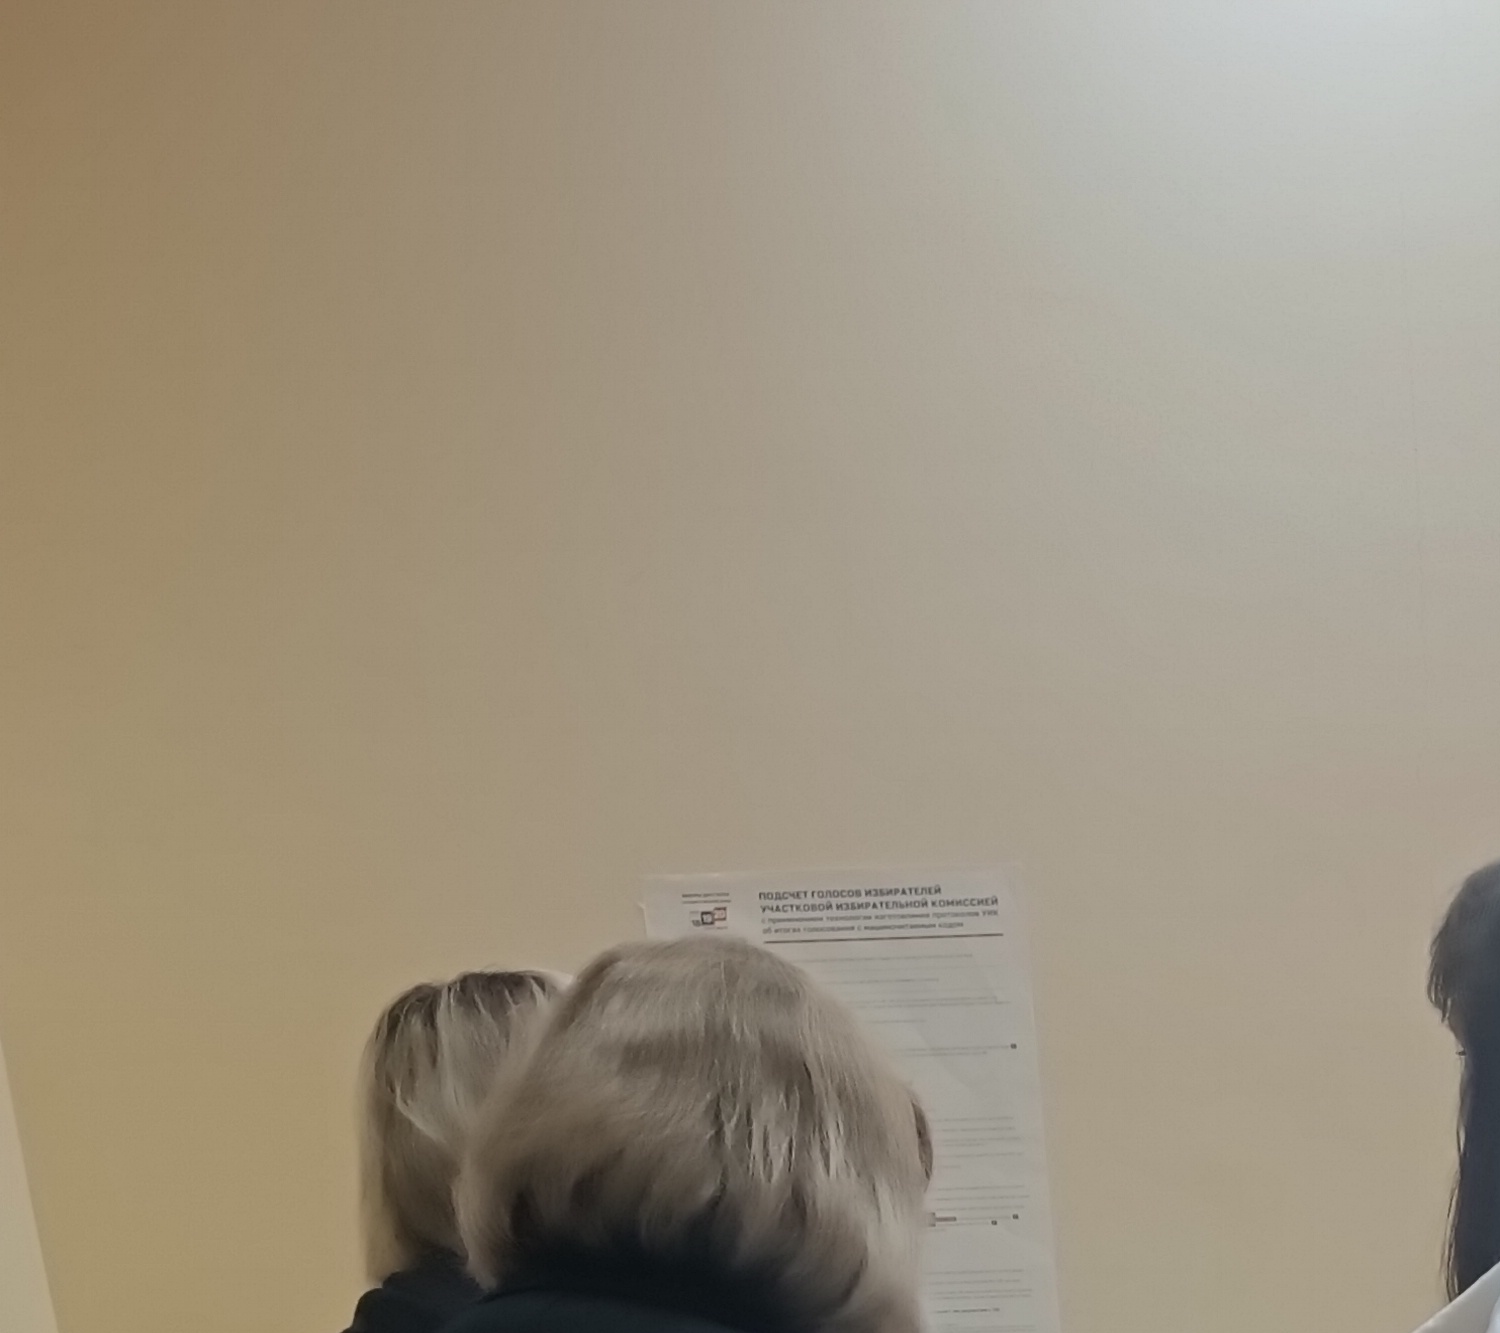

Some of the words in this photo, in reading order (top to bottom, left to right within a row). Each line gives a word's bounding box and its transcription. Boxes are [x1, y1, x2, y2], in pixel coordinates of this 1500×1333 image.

[758, 890, 808, 901] ПОДСЧЕТ
[811, 889, 862, 899] ГОЛОСОВ
[865, 884, 941, 897] ИЗБИРАТЕЛЕЙ
[760, 900, 833, 913] УЧАСТКОВОЙ
[836, 898, 928, 911] ИЗБИРАТЕЛЬНОЙ
[931, 896, 999, 908] КОМИССИЕЙ
